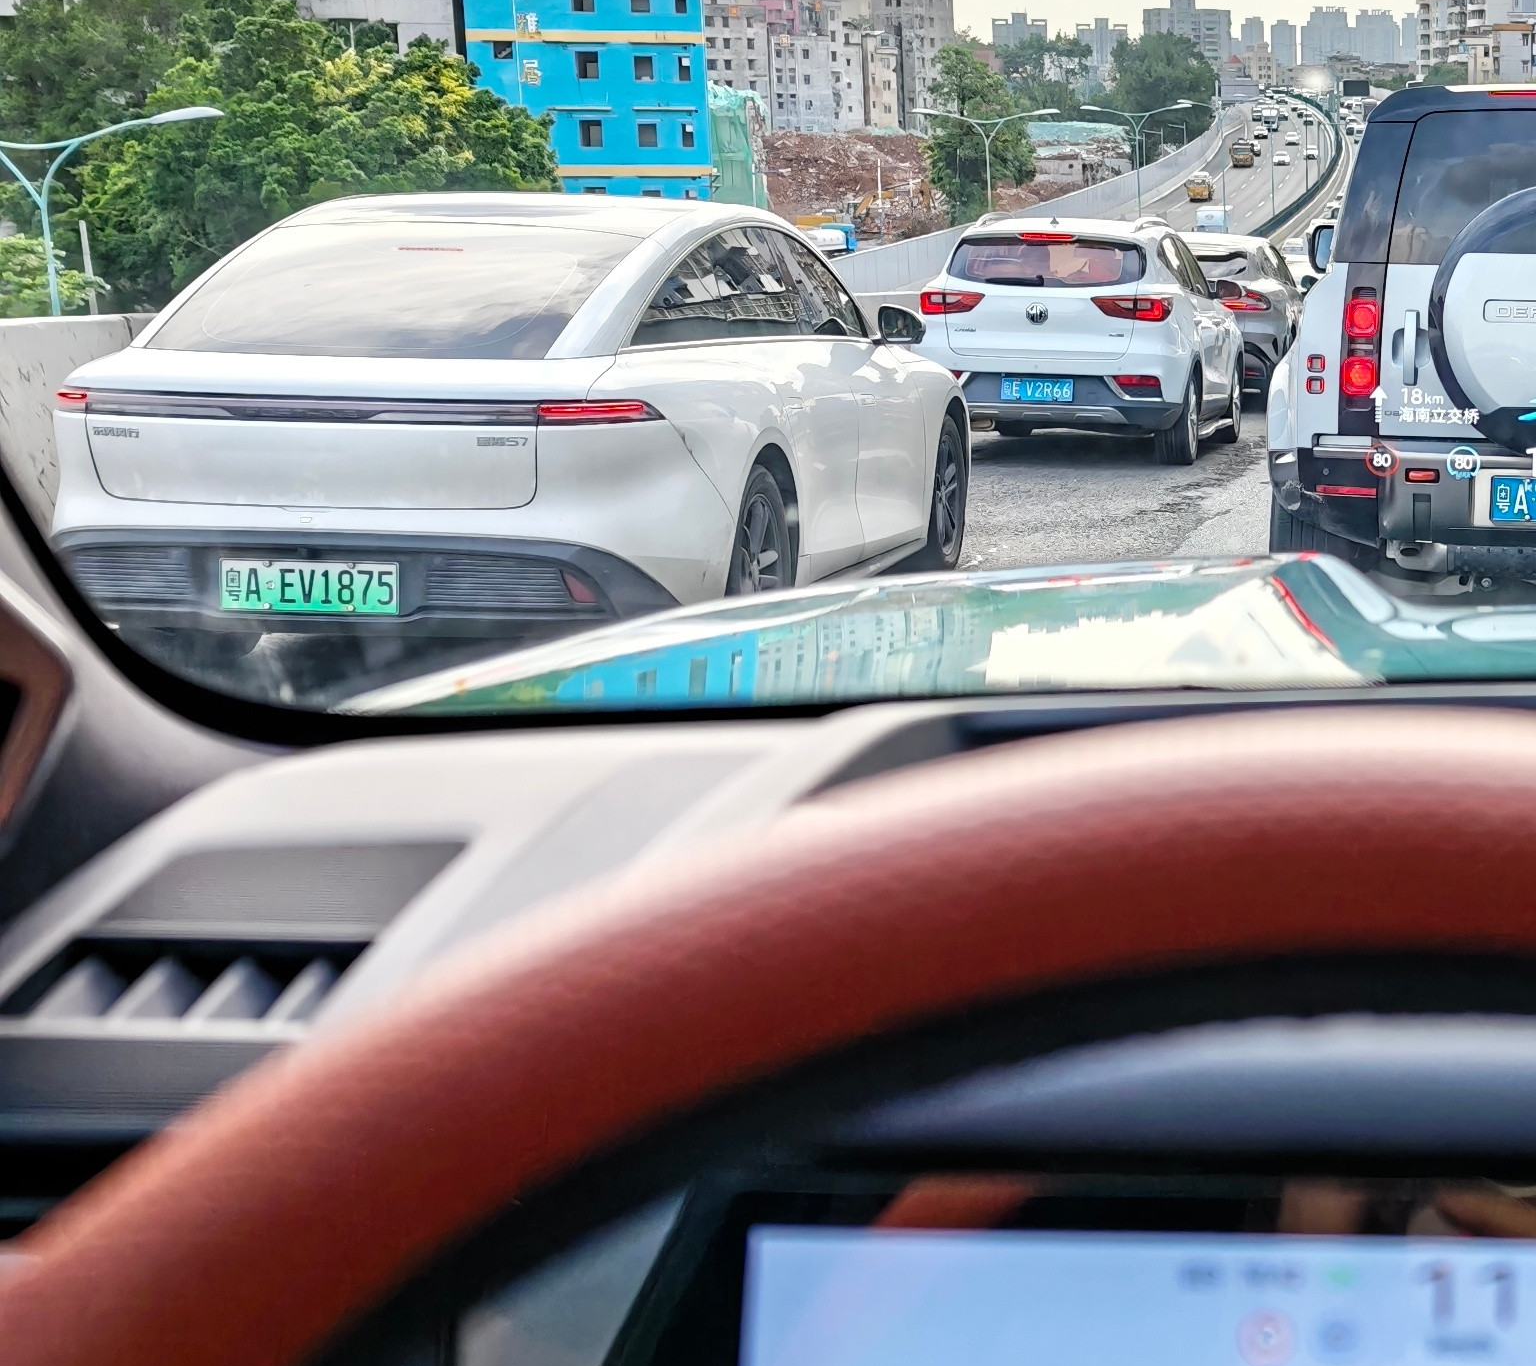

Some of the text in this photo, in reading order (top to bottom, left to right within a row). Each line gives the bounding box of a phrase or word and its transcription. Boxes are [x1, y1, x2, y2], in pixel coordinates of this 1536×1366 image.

[1399, 406, 1480, 425] 海南立交桥
[1372, 453, 1392, 467] 80
[1454, 455, 1473, 470] 80
